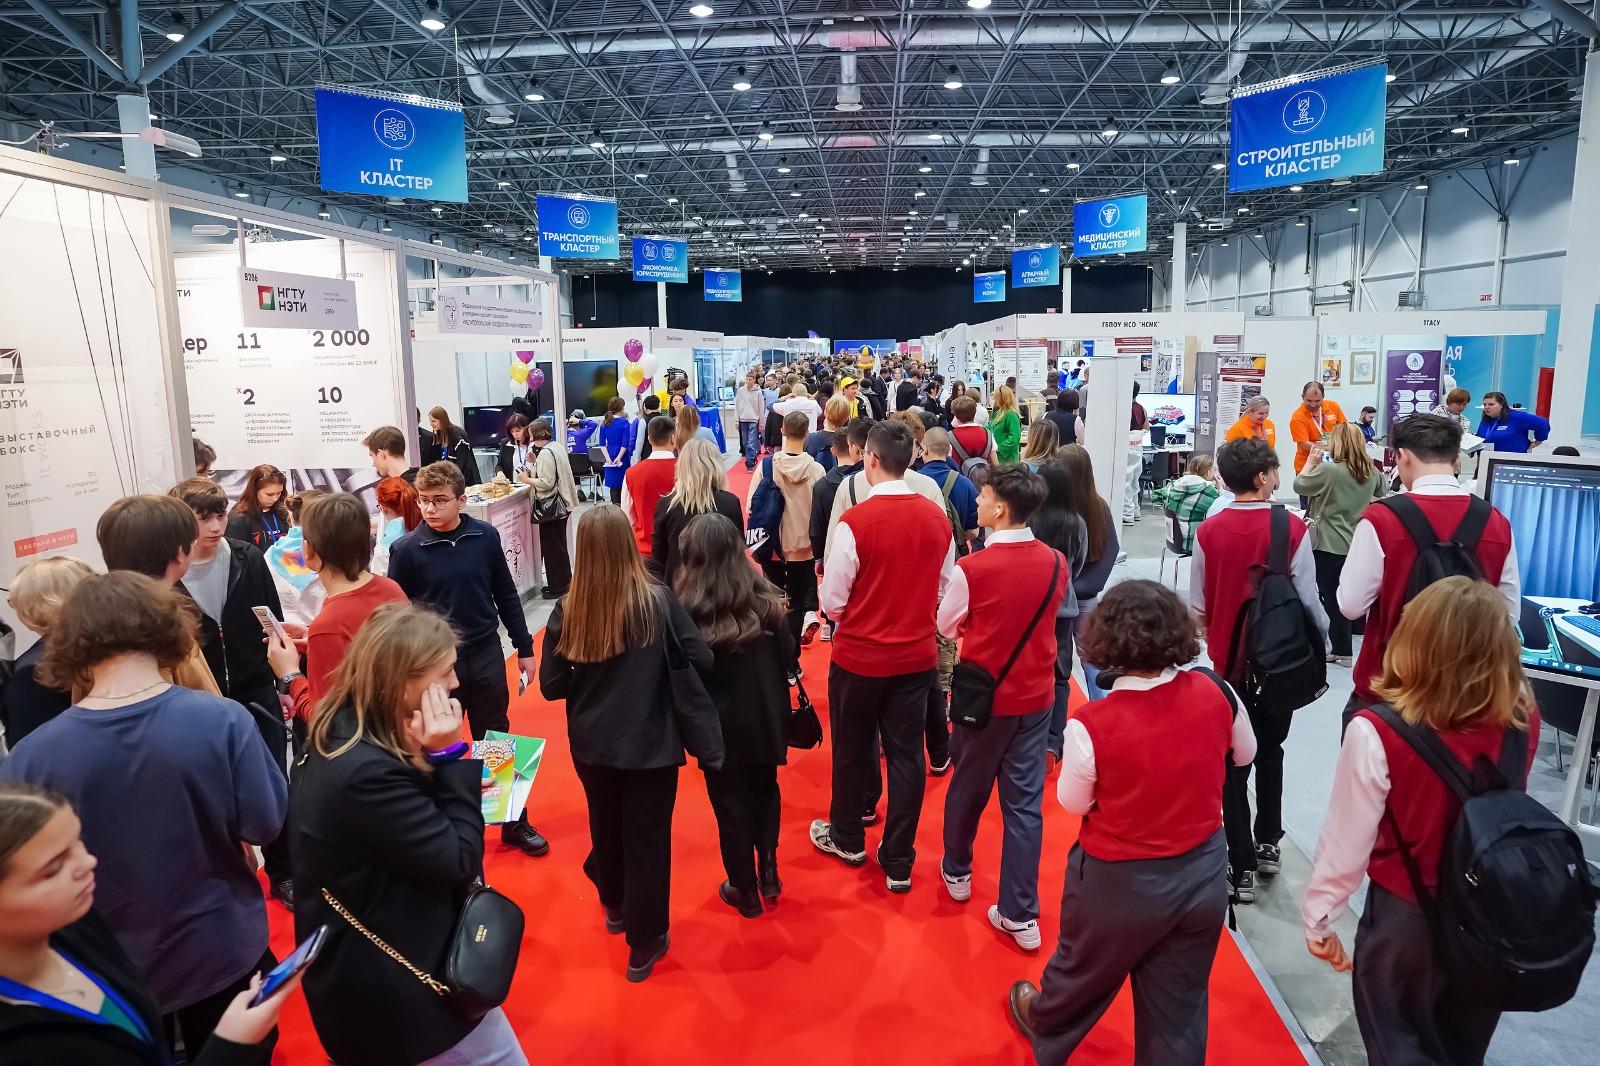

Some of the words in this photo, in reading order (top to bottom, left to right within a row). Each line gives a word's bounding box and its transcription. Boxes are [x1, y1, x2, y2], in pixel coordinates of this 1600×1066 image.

[1237, 128, 1375, 167] СТРОИТЕЛЬНЫЙ
[390, 158, 404, 172] IT
[1265, 154, 1341, 178] КЛАСТЕР
[360, 170, 433, 190] КЛАСТЕР
[542, 232, 615, 244] ТРАНСПОРТНЫЙ
[1078, 228, 1141, 243] МЕДИЦИНСКИЙ
[560, 242, 600, 253] КЛАСТЕР
[1090, 240, 1128, 251] КЛАСТЕР
[1022, 268, 1050, 278] АГРАРНЫЙ
[277, 286, 306, 299] НГТУ
[279, 300, 308, 312] НЭТИ
[182, 337, 208, 354] ер
[238, 332, 262, 350] 11
[312, 330, 326, 347] 2
[330, 329, 370, 346] 000
[948, 346, 956, 372] Окна
[1446, 346, 1462, 360] АЯ
[242, 388, 256, 405] 2
[318, 386, 342, 403] 10
[0, 444, 36, 456] БОКС
